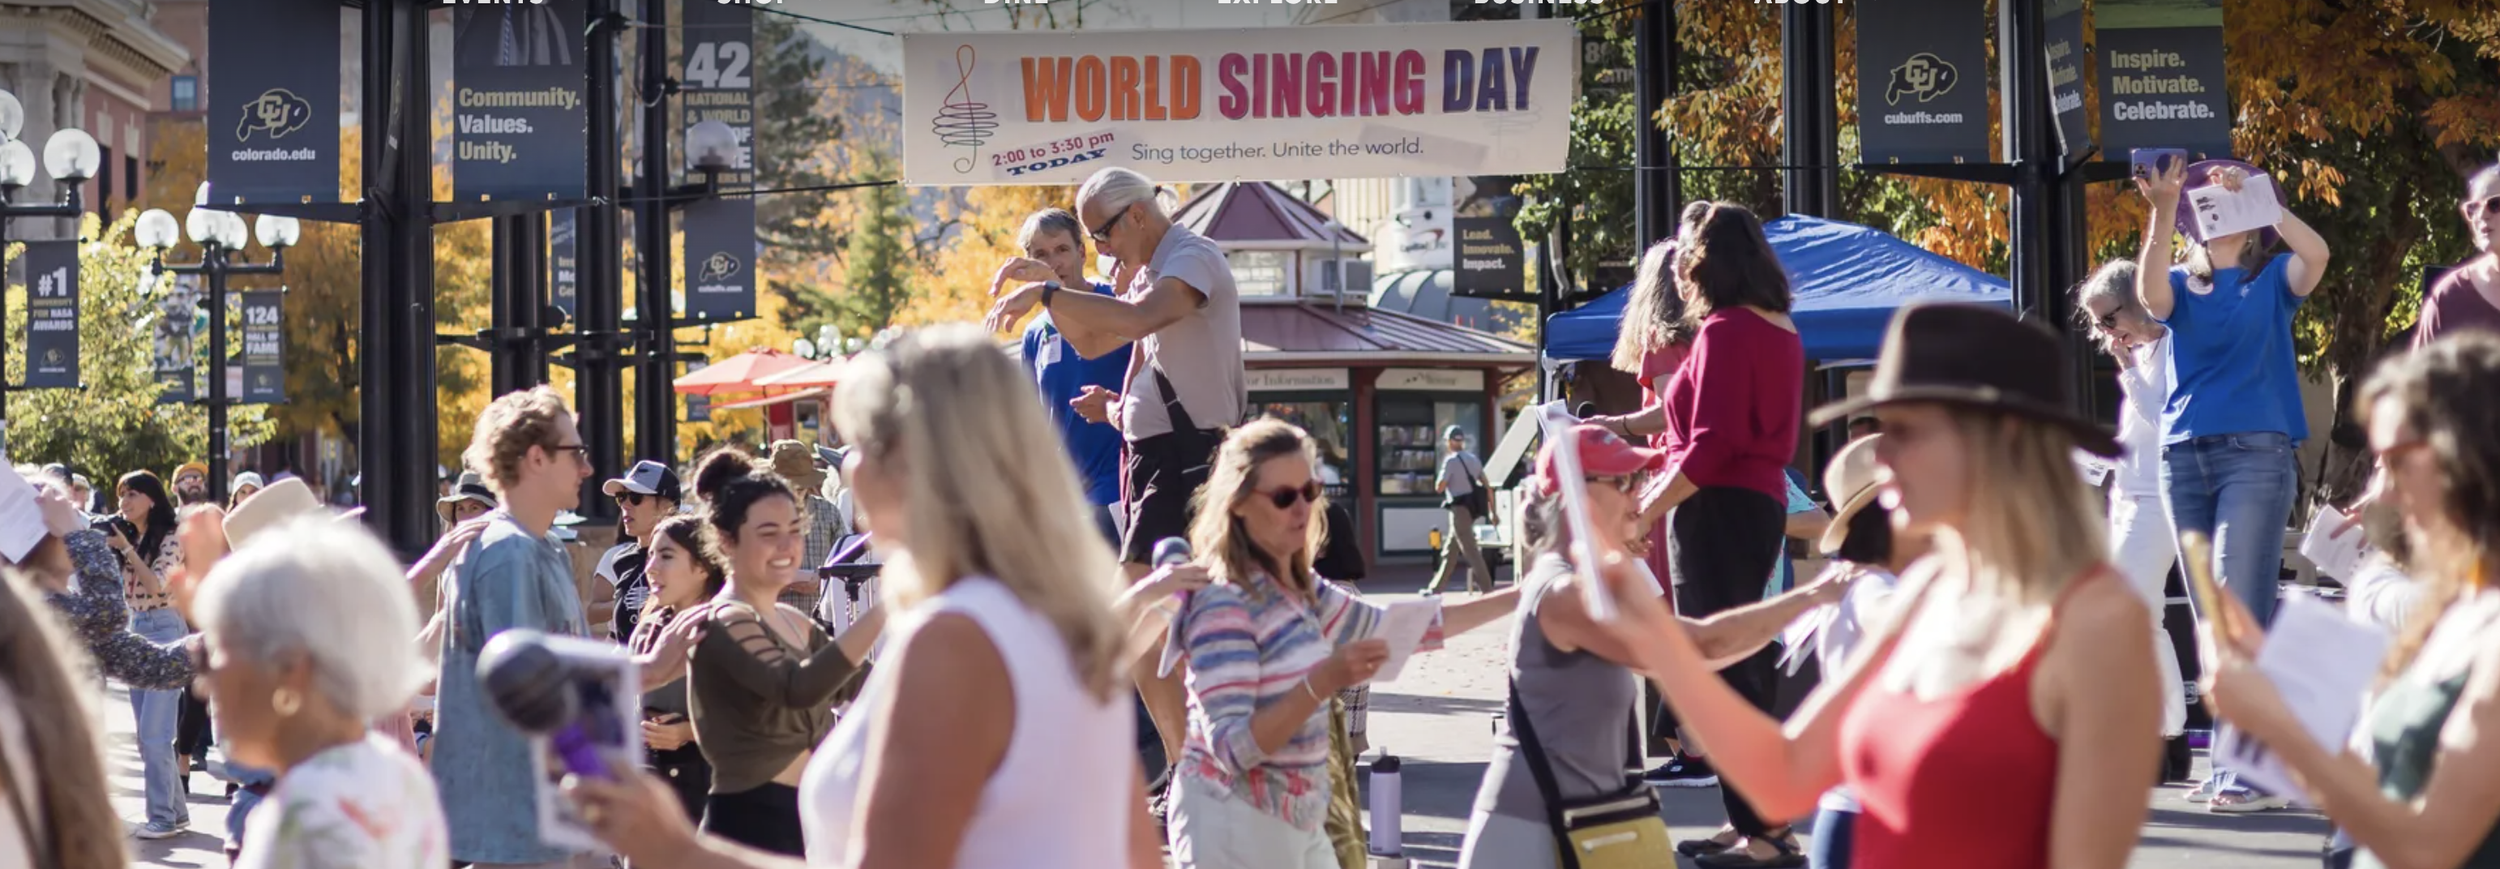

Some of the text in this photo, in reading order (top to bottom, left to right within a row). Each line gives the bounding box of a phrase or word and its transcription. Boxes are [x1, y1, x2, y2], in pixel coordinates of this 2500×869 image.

[686, 41, 751, 88] 42
[2110, 49, 2186, 72] Inspire.
[1021, 46, 1540, 122] WORLD SINGING DAY
[2112, 75, 2205, 94] Motivate.
[459, 87, 580, 110] Community.
[687, 92, 750, 105] NATIONAL
[687, 109, 750, 123] & WORLD
[1884, 111, 1963, 124] cubuffs.com
[2113, 100, 2215, 121] Celebrate.
[459, 114, 533, 134] Values.
[231, 147, 316, 161] colorado.edu
[459, 141, 517, 164] Unity.
[992, 132, 1115, 166] 2:00 to 3:30 pm
[1132, 137, 1424, 165] Sing together. Unite the world.
[1007, 148, 1107, 176] TODAY
[1463, 229, 1493, 240] Lead.
[1463, 244, 1514, 255] Innovate.
[1463, 258, 1505, 271] Impact.
[38, 266, 67, 297] #1
[33, 319, 74, 331] AWARDS
[246, 305, 279, 325] 124
[246, 341, 279, 355] FAME
[1264, 373, 1336, 386] Information
